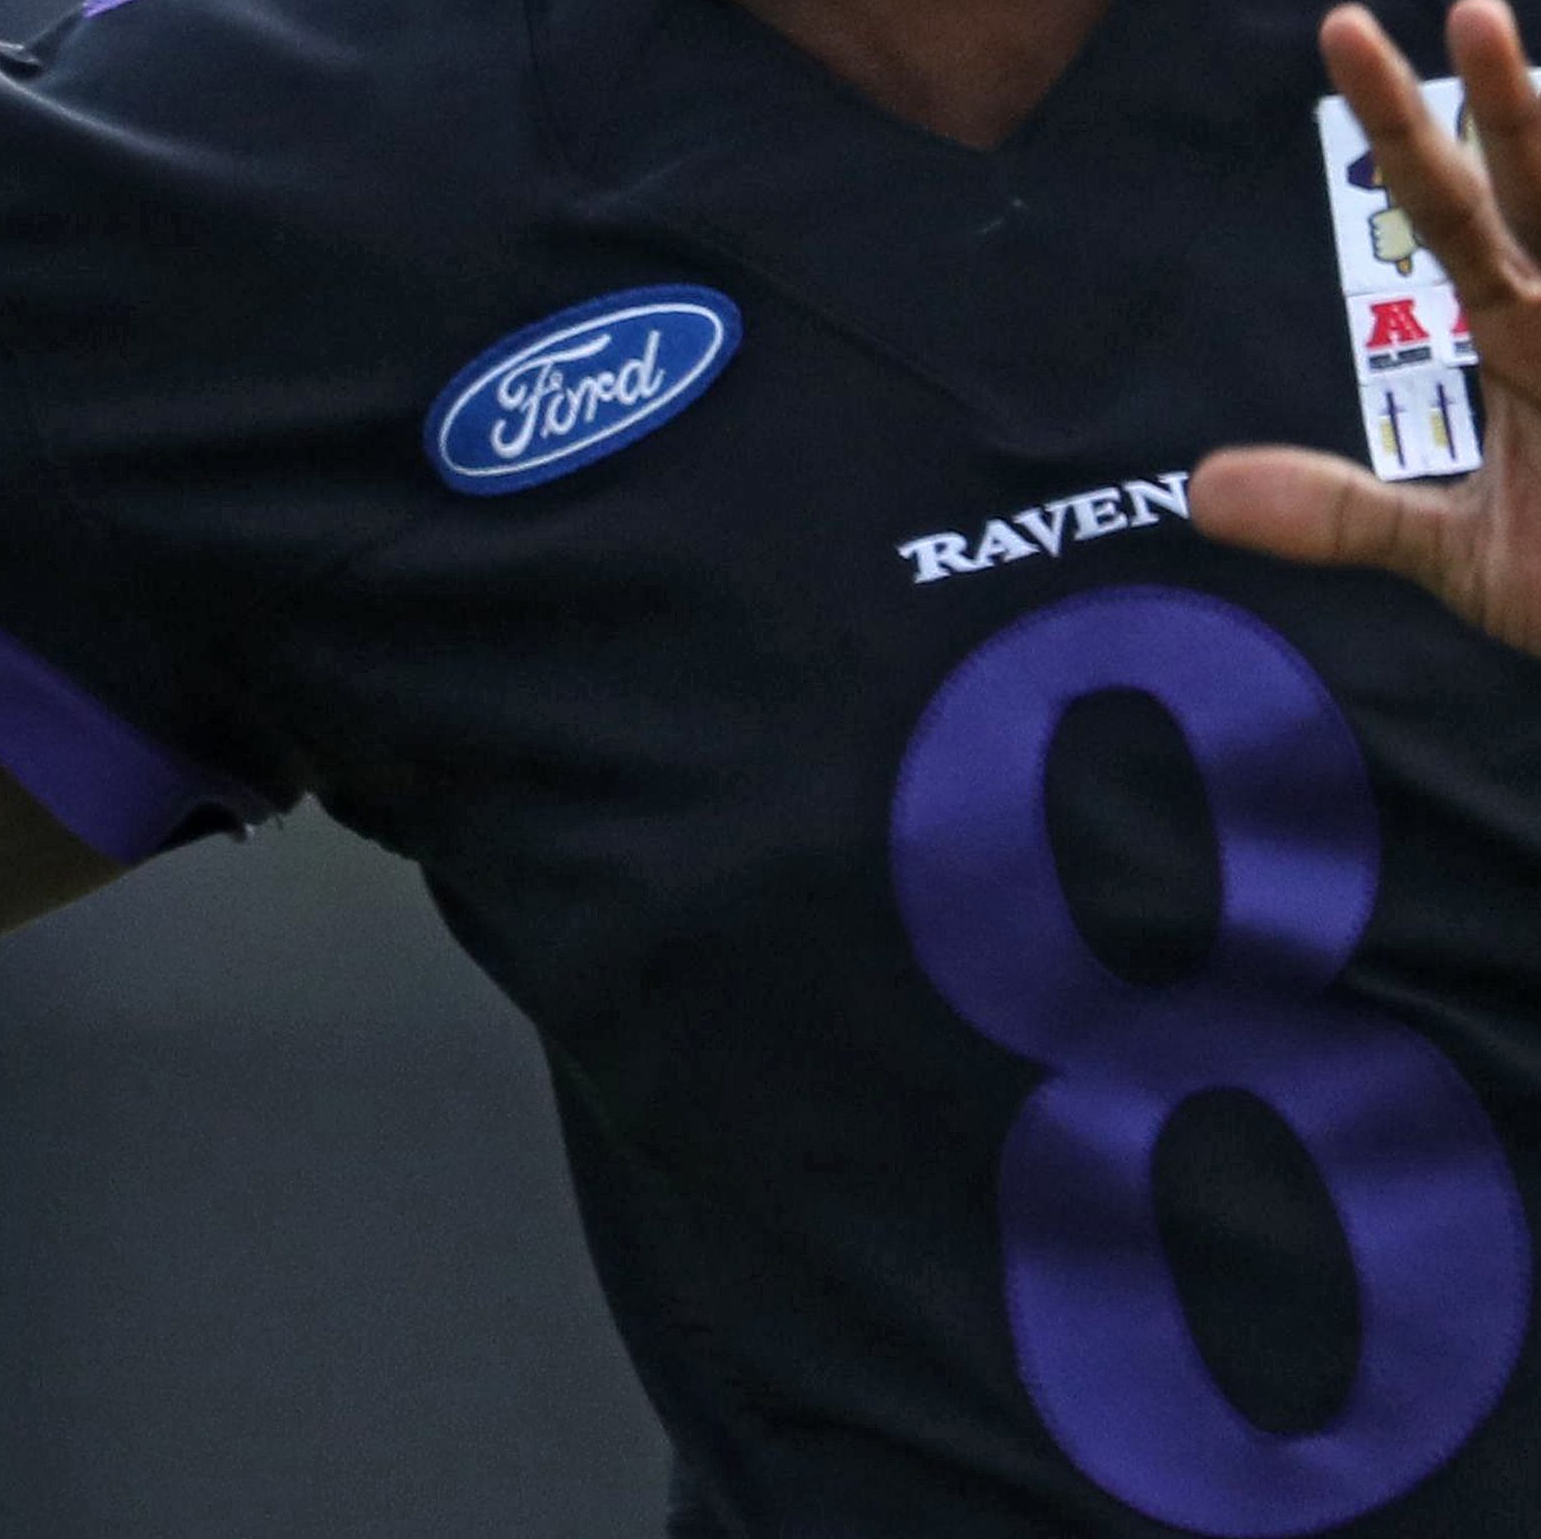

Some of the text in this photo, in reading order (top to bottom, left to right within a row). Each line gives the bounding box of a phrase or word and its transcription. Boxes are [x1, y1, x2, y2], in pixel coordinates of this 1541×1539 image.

[490, 329, 664, 459] Ford
[896, 470, 1191, 585] RAVEN
[889, 583, 1533, 1538] 8
